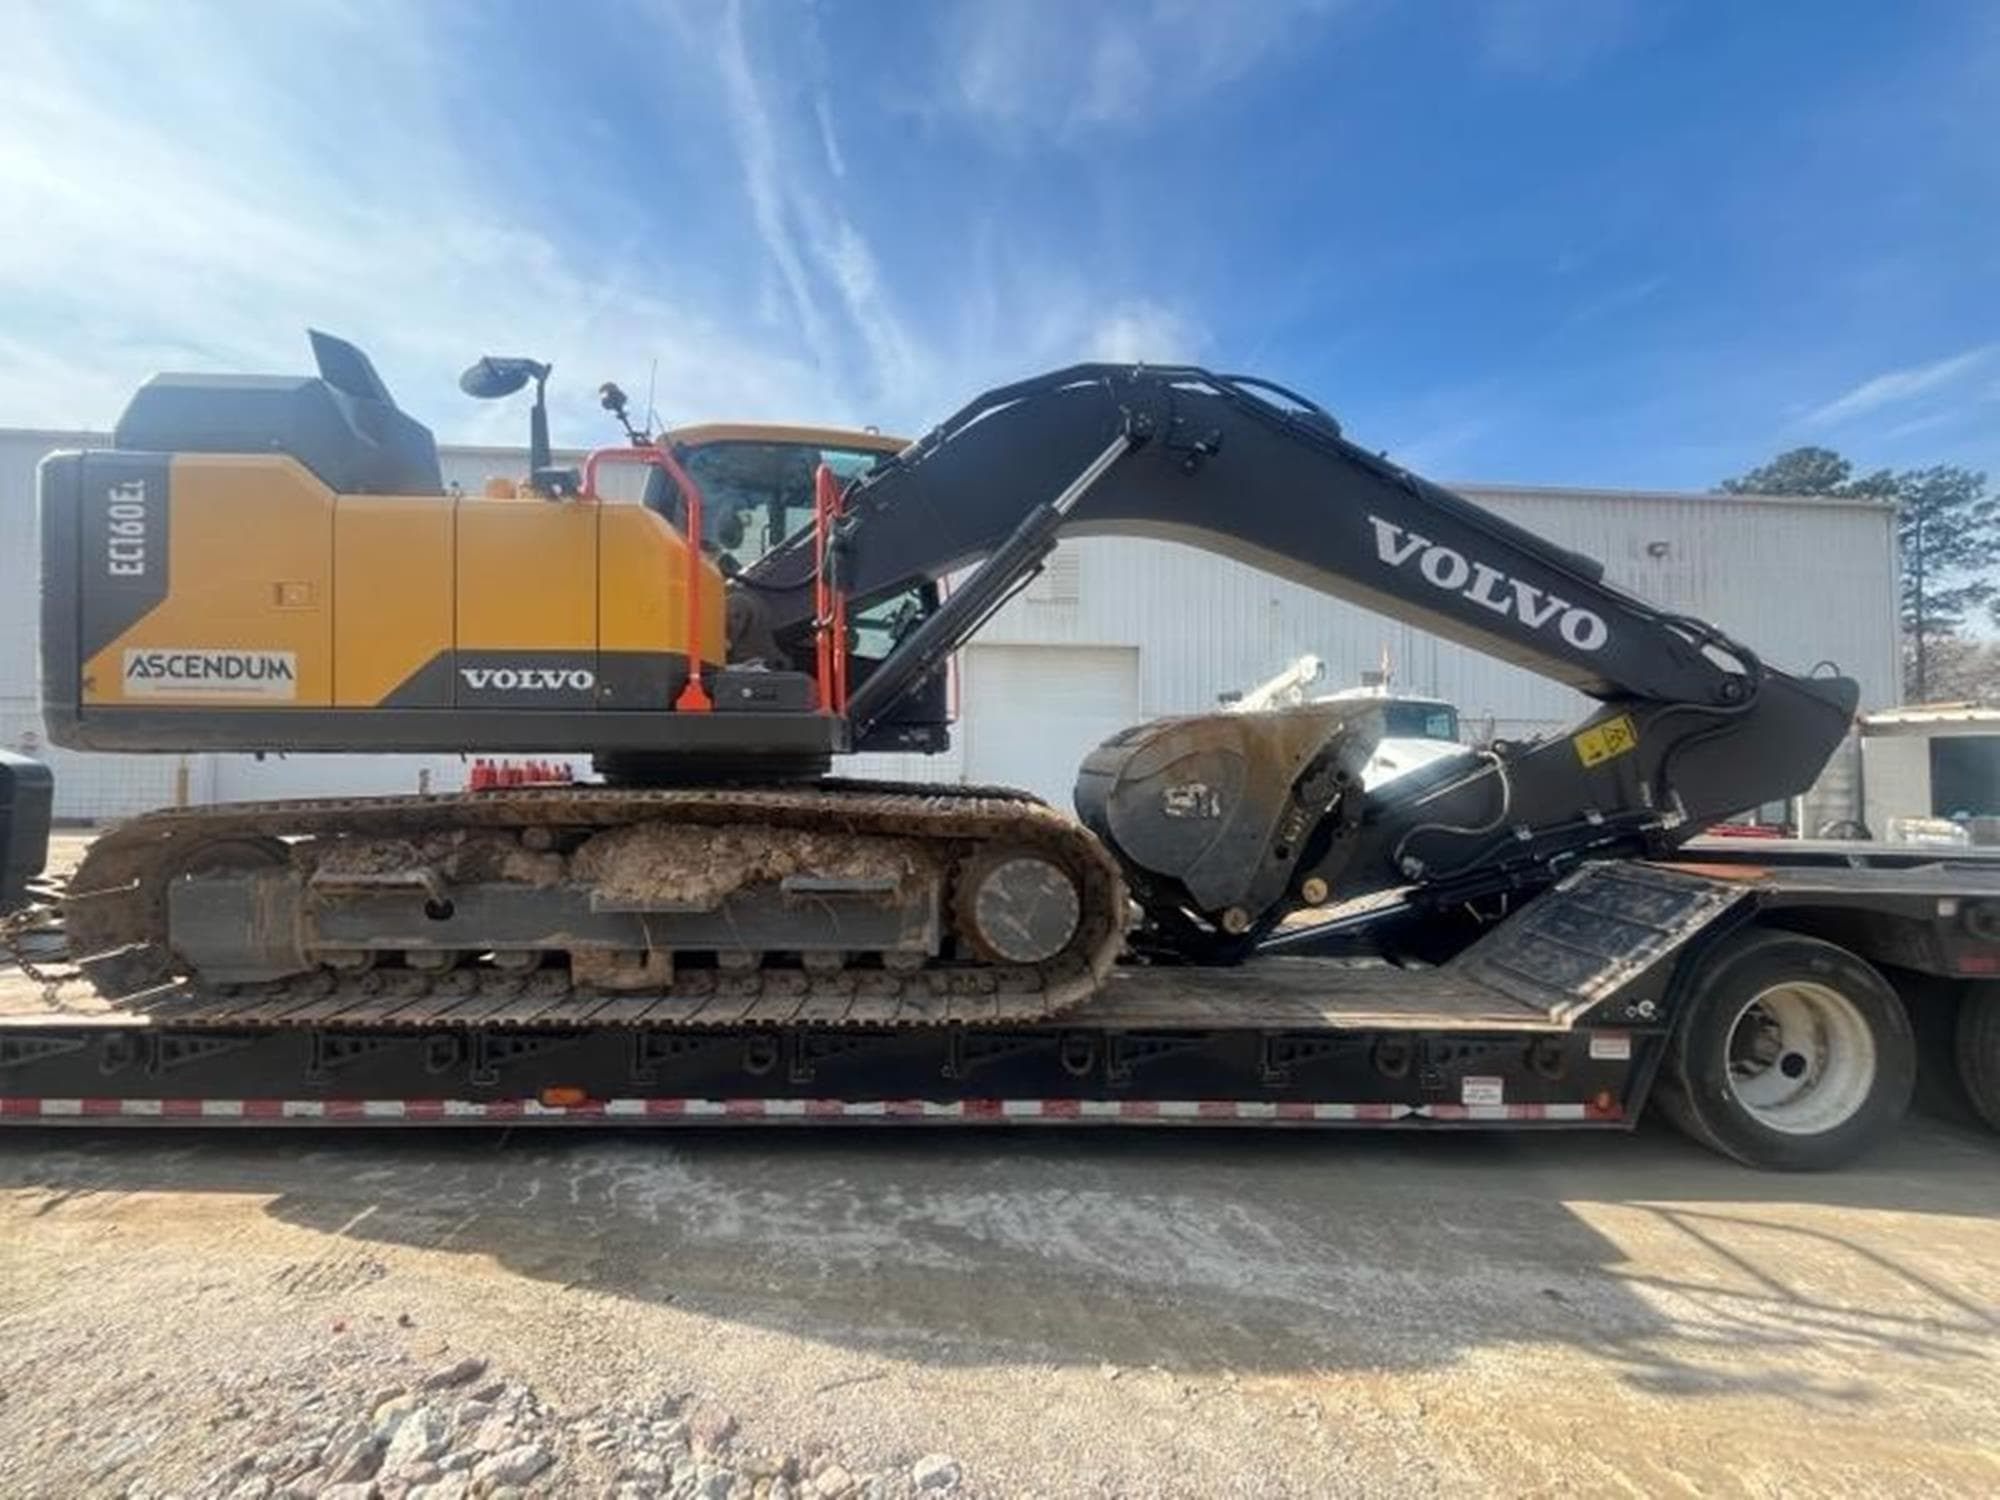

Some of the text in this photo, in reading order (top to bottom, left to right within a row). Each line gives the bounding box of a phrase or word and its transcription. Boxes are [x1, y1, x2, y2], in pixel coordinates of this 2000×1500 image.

[1368, 515, 1608, 651] VOLVO
[126, 654, 293, 680] ASCENDUM
[459, 668, 594, 690] VOLVO
